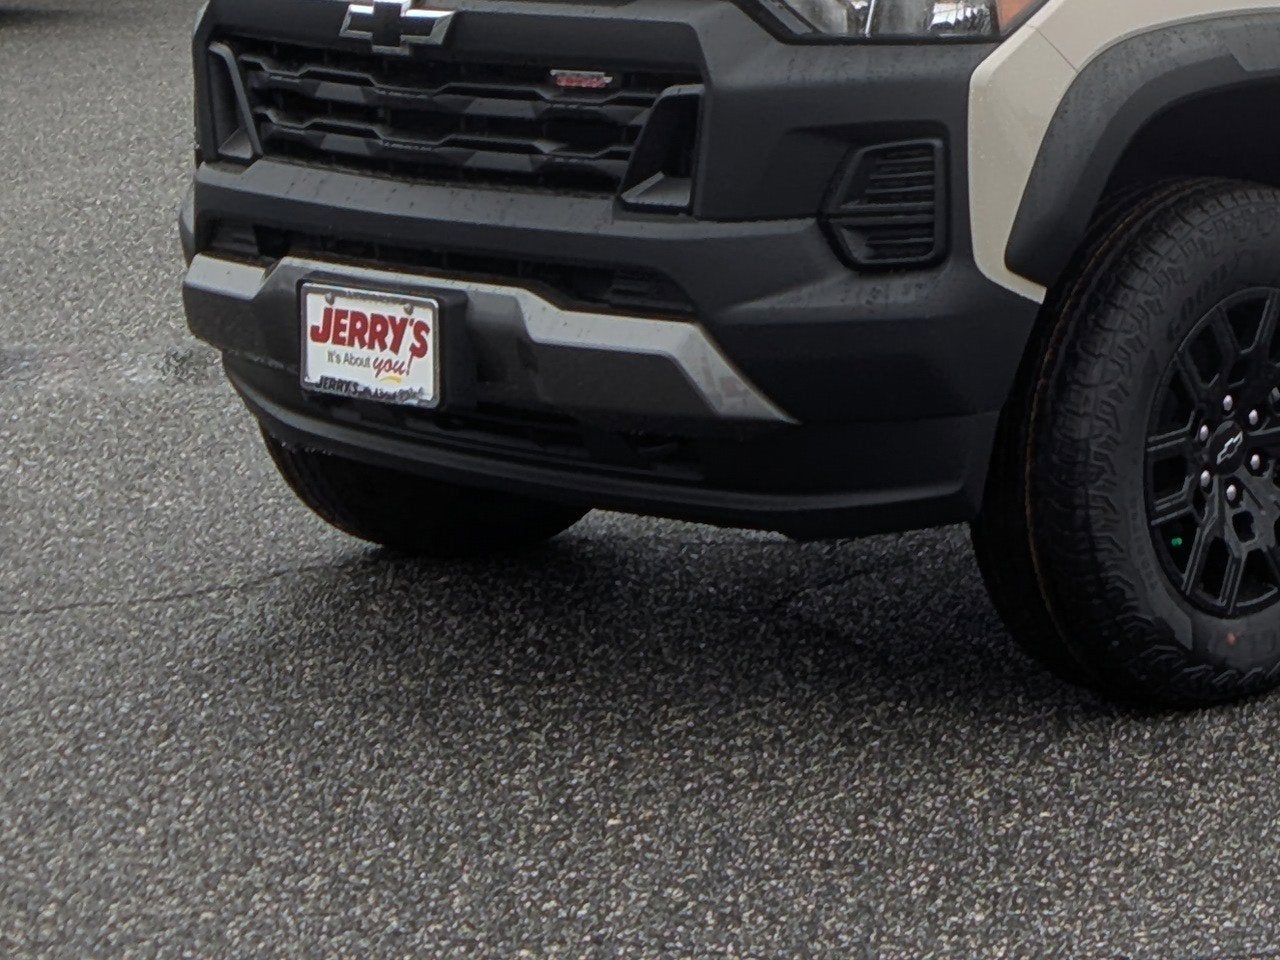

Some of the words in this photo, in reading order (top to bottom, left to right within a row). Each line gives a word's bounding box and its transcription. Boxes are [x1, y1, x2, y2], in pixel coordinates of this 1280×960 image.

[310, 307, 430, 358] JERRY'S
[326, 348, 342, 365] It's
[342, 352, 371, 369] About
